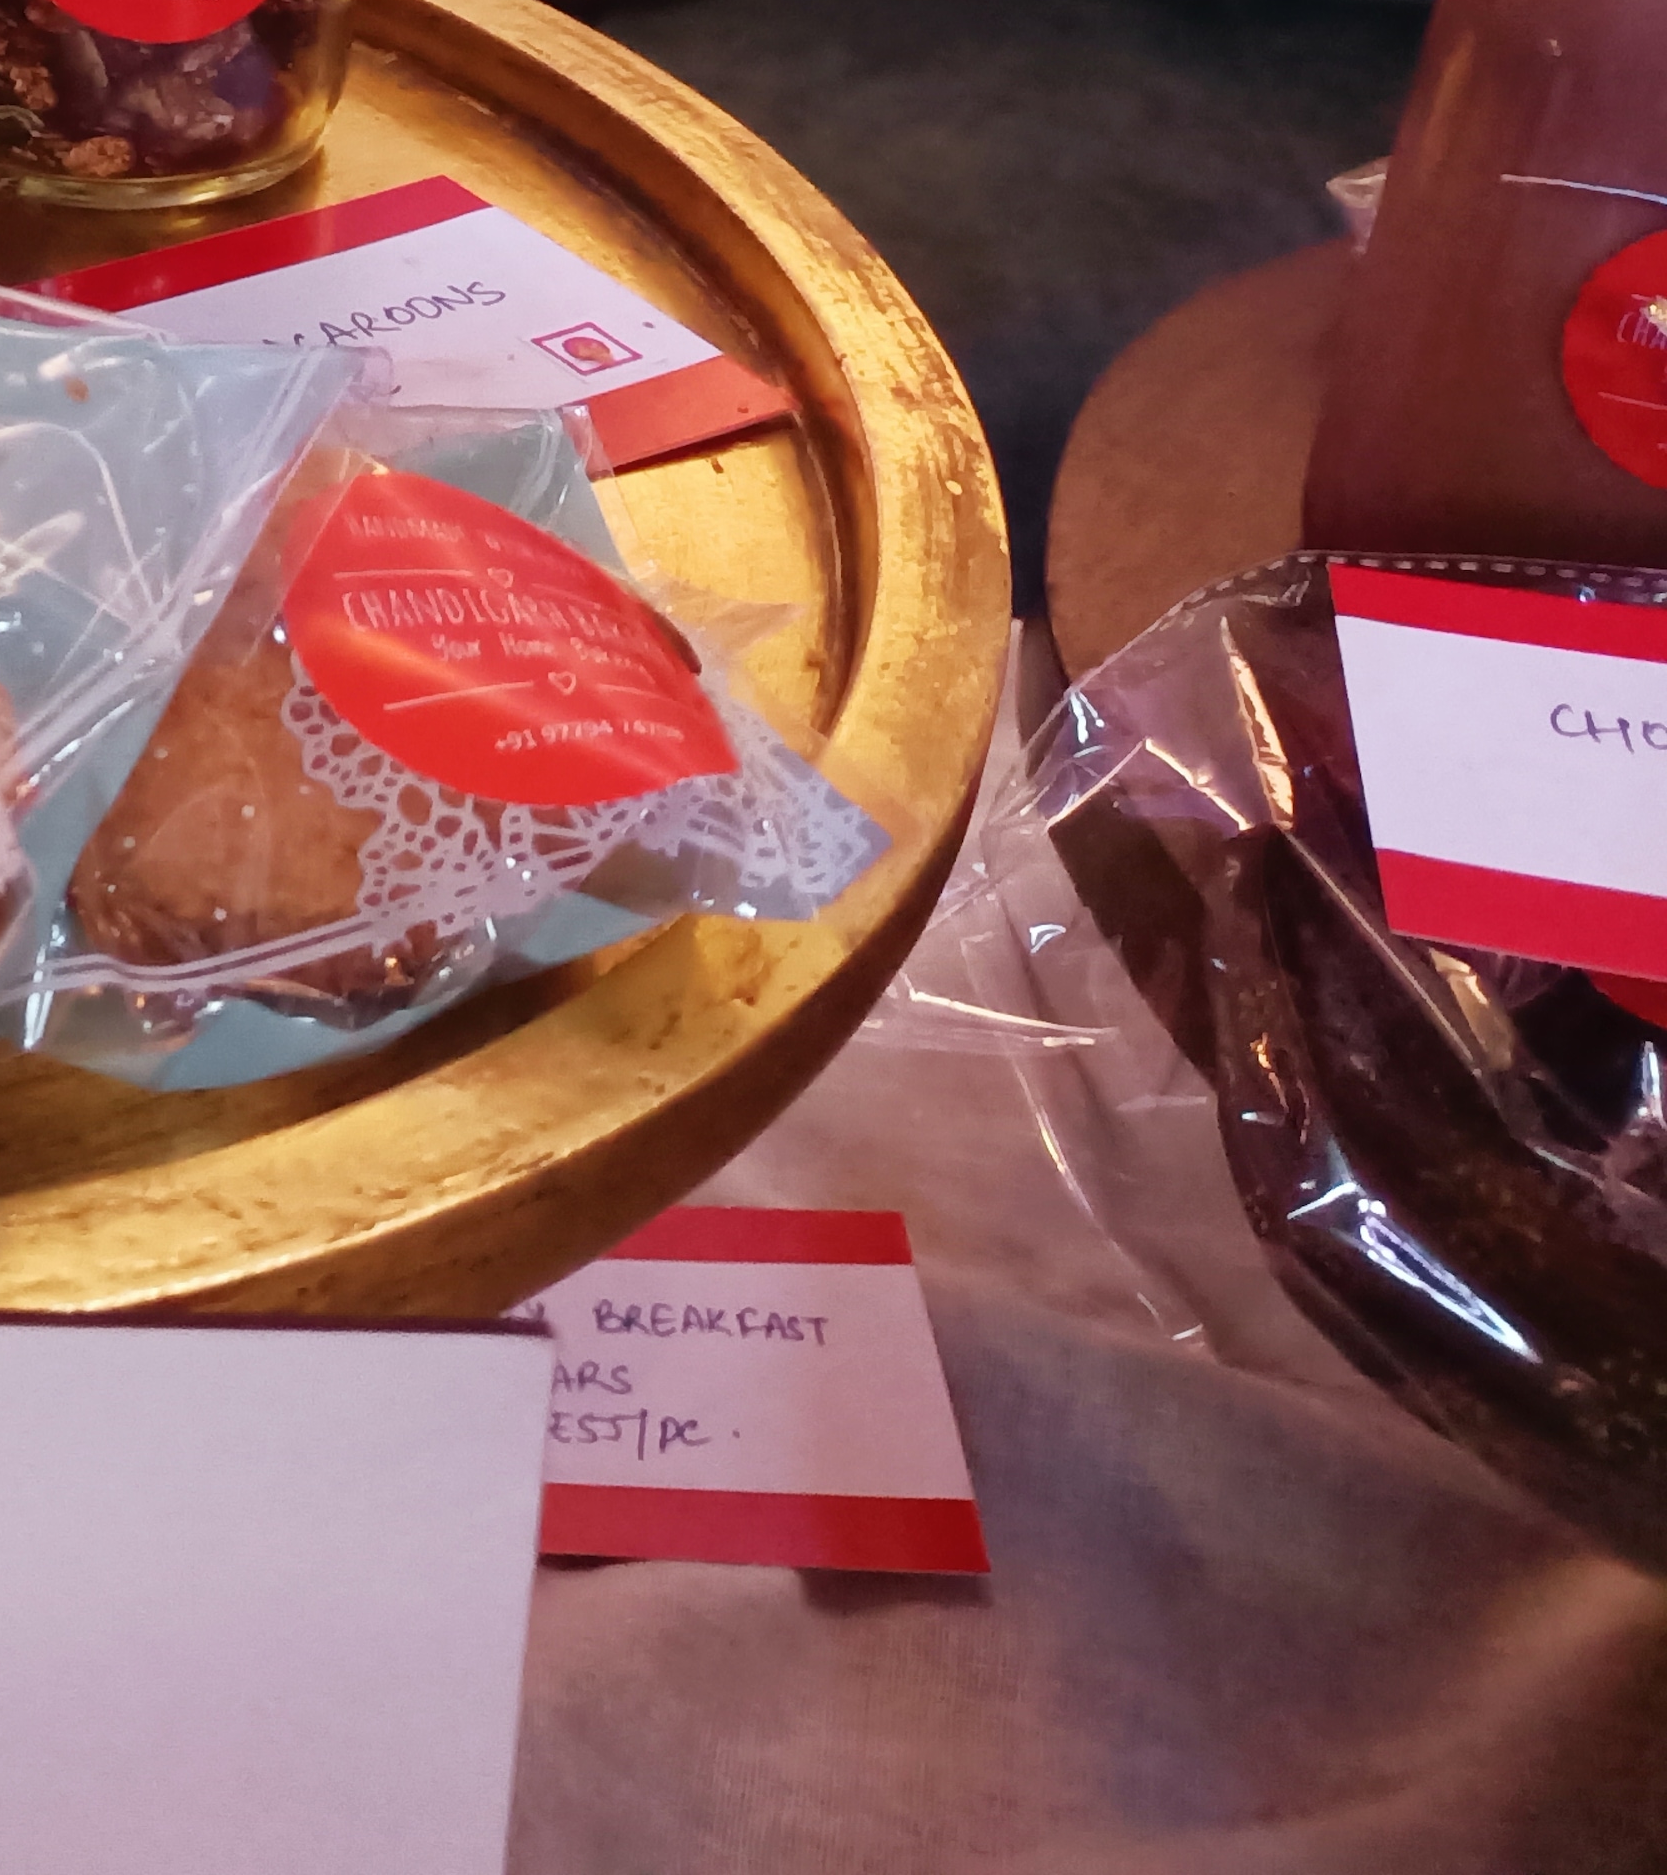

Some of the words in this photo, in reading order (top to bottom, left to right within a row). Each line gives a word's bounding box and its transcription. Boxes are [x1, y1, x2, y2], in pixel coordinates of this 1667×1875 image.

[262, 281, 507, 347] AROONS
[592, 1298, 831, 1346] BREAKFAST
[551, 1359, 633, 1395] ARS
